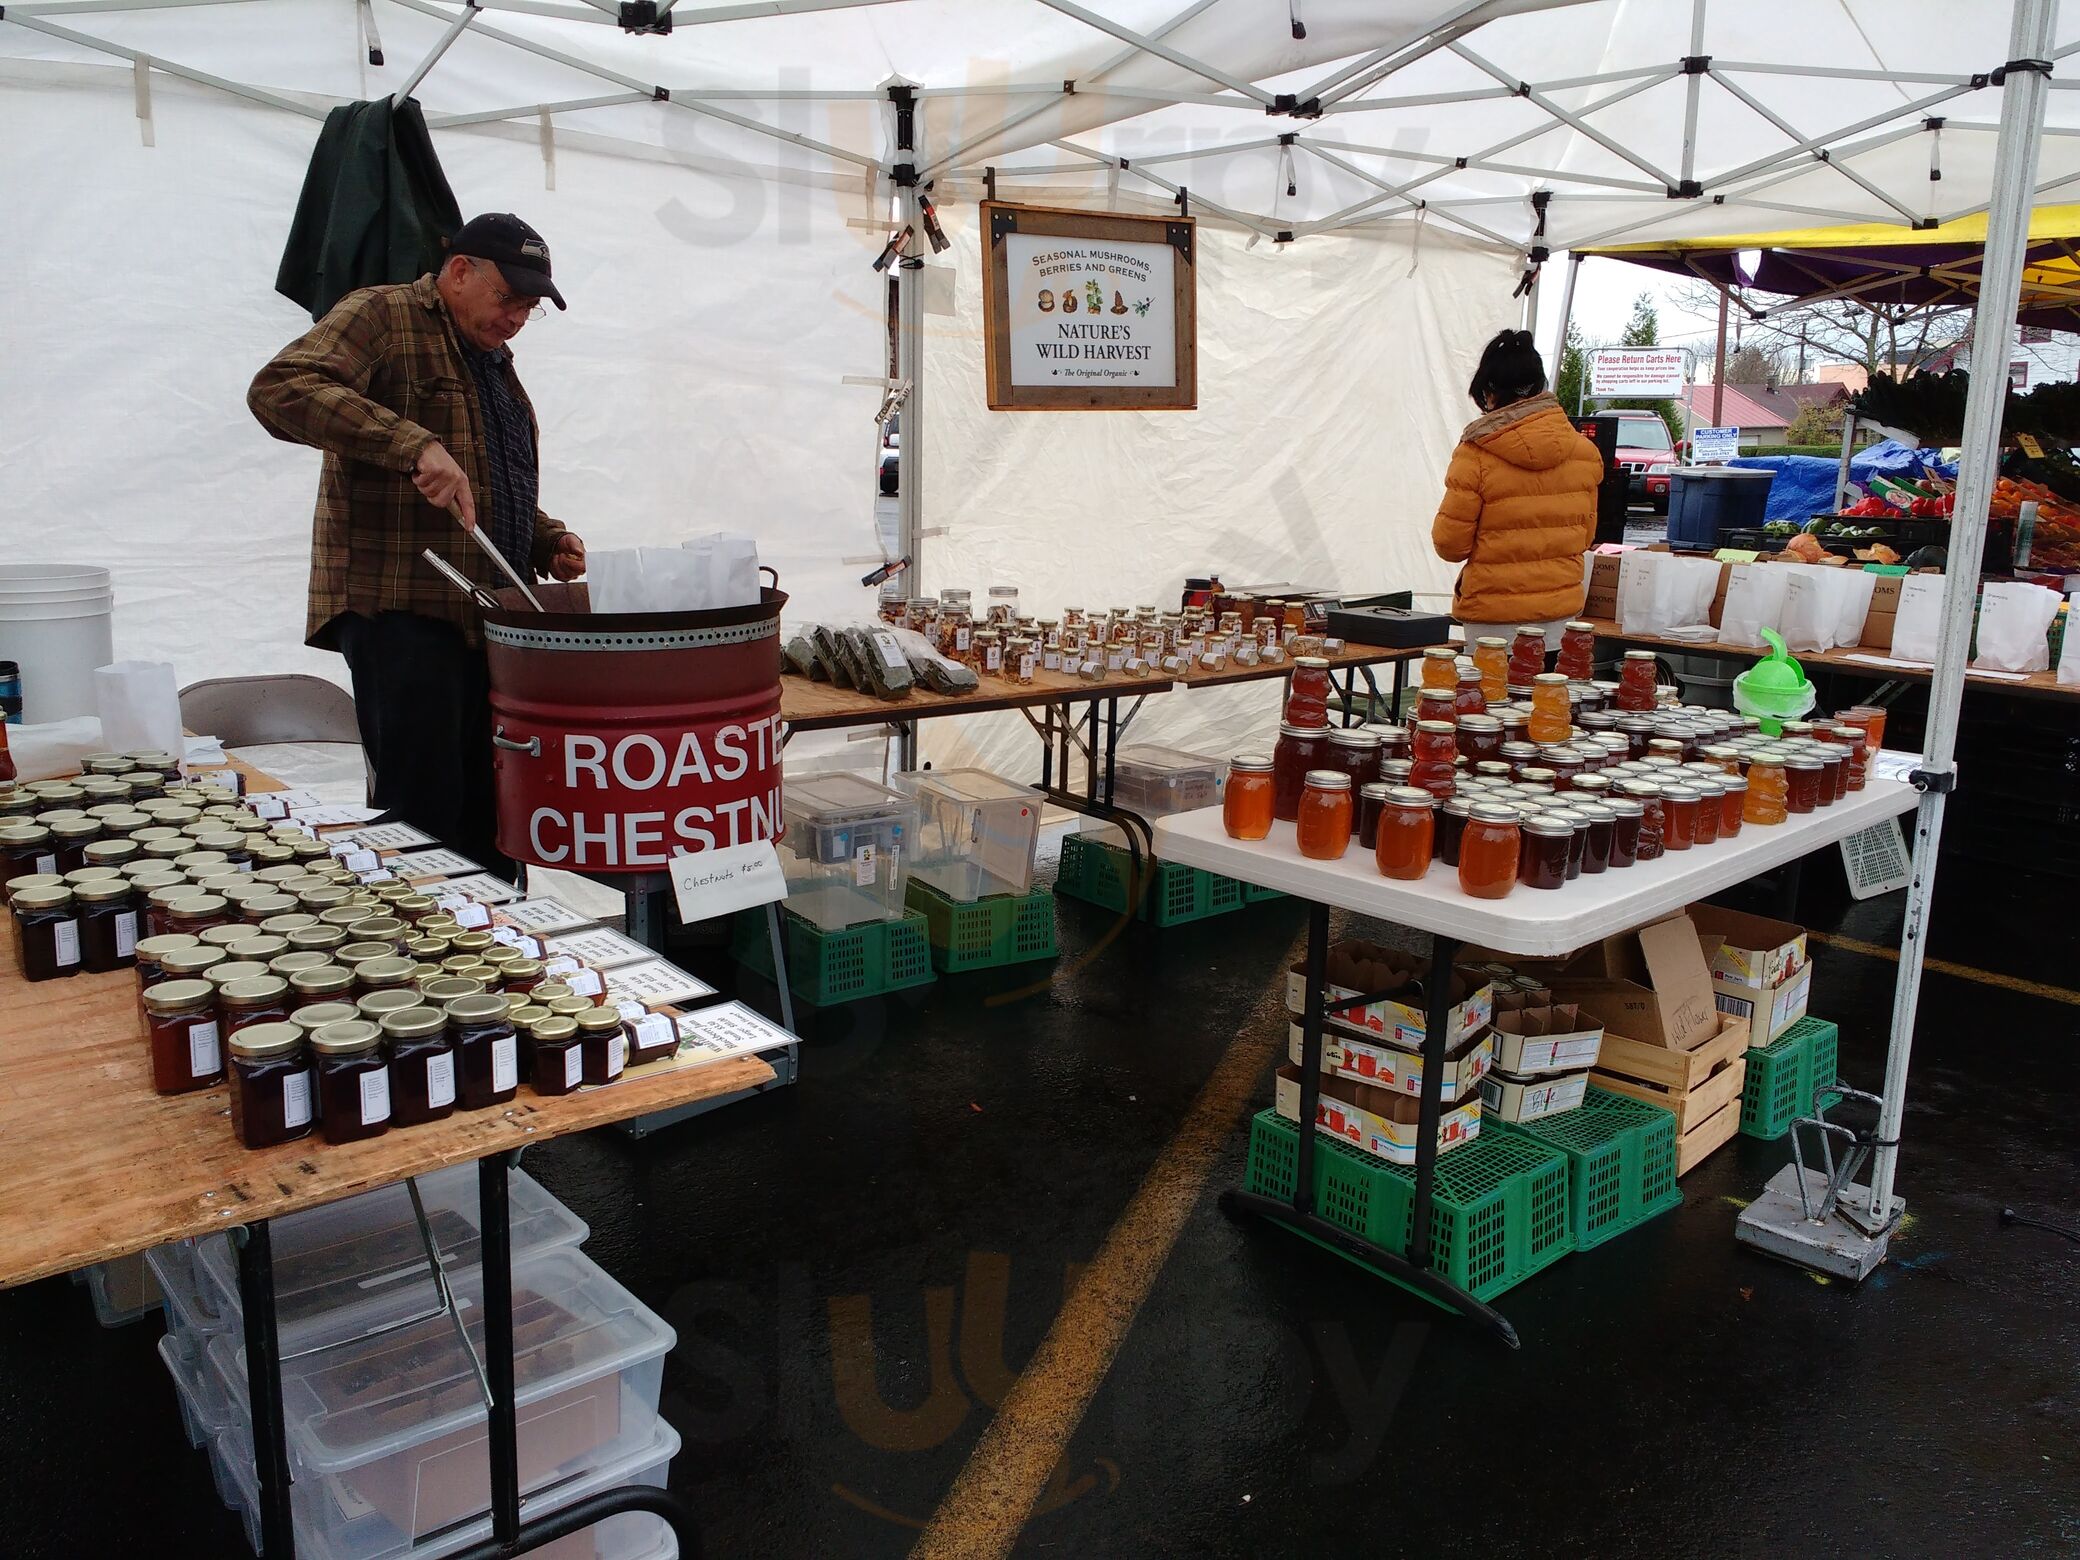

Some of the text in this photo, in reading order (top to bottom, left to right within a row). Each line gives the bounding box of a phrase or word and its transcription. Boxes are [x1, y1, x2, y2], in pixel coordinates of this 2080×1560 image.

[1032, 250, 1152, 274] SEASONAL MUSHROOMS,
[1039, 263, 1146, 282] BERRIES AND GREENS
[1058, 324, 1130, 340] NATURE'S
[1036, 344, 1151, 360] WILD HARVEST
[1598, 355, 1681, 364] Please Return Carts Here
[1064, 369, 1127, 378] The Original Organic
